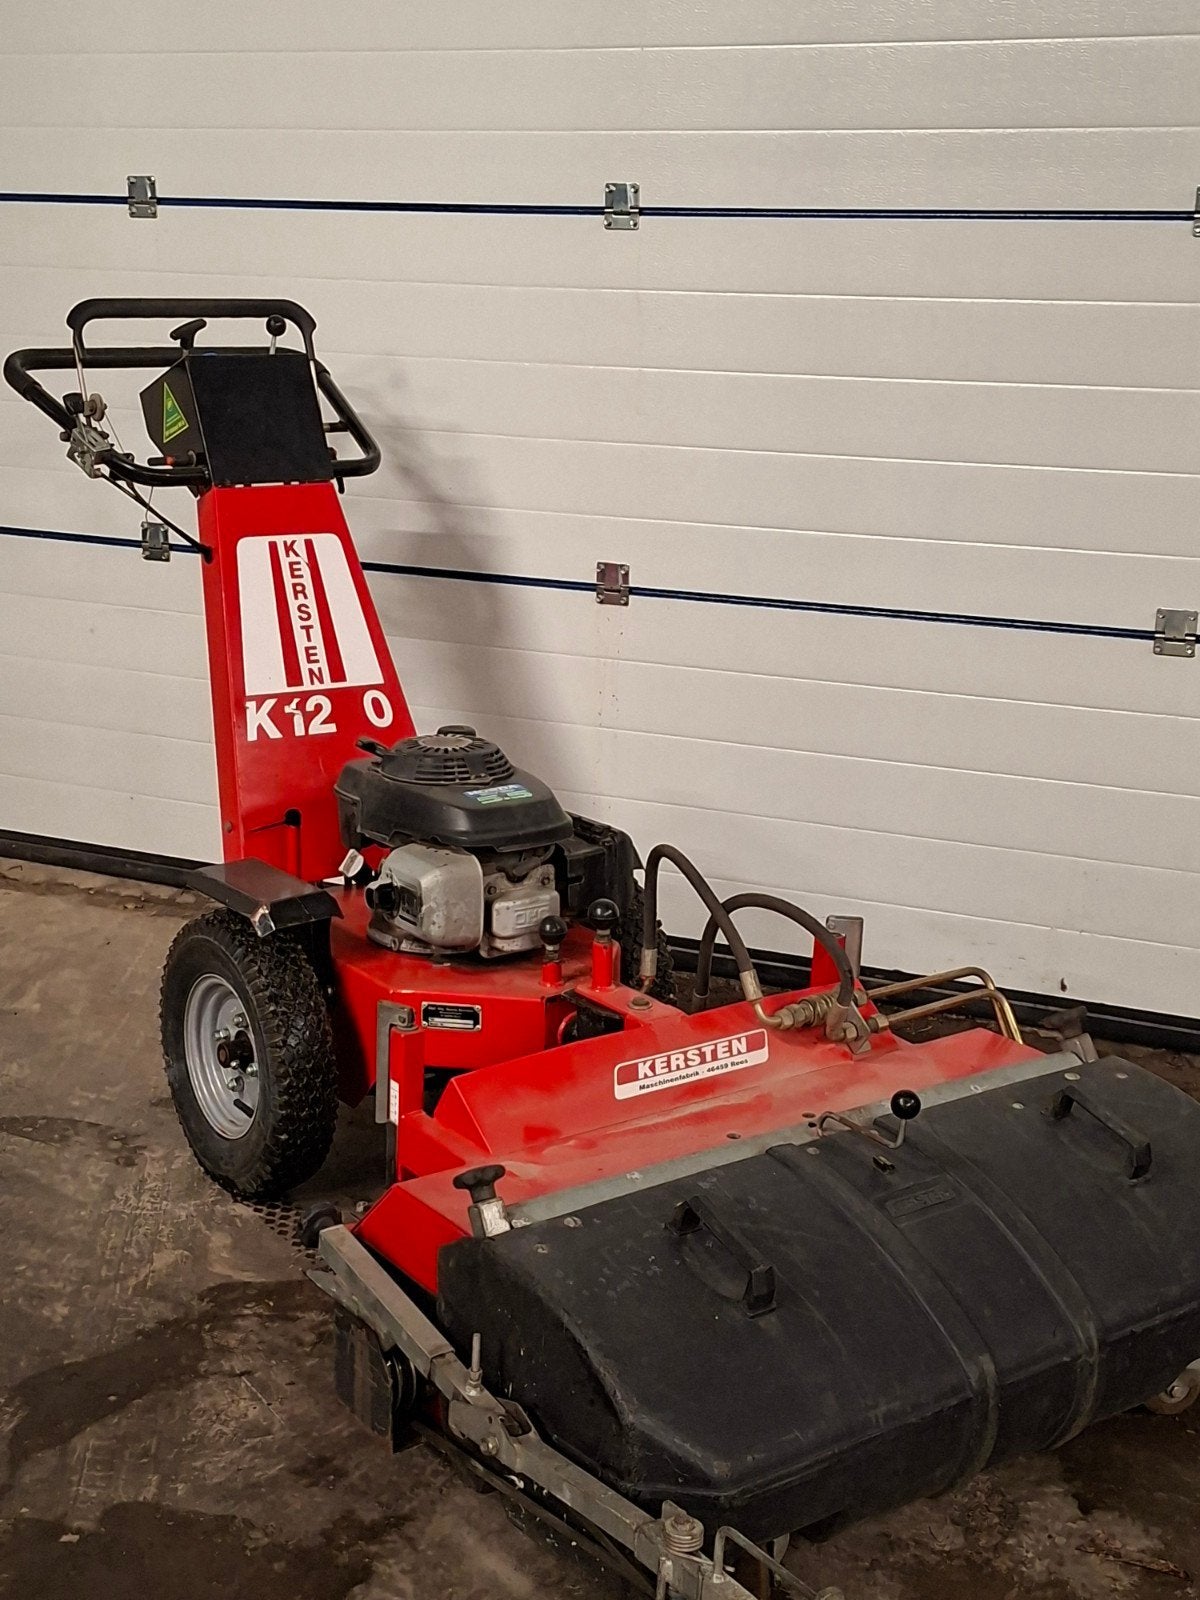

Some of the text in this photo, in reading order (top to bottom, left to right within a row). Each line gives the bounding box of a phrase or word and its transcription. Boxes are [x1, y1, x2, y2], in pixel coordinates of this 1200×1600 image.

[283, 539, 325, 686] KERSTEN
[637, 1036, 748, 1080] KERSTEN
[638, 1070, 700, 1091] Maschinenfabrik
[730, 1059, 749, 1067] Rees
